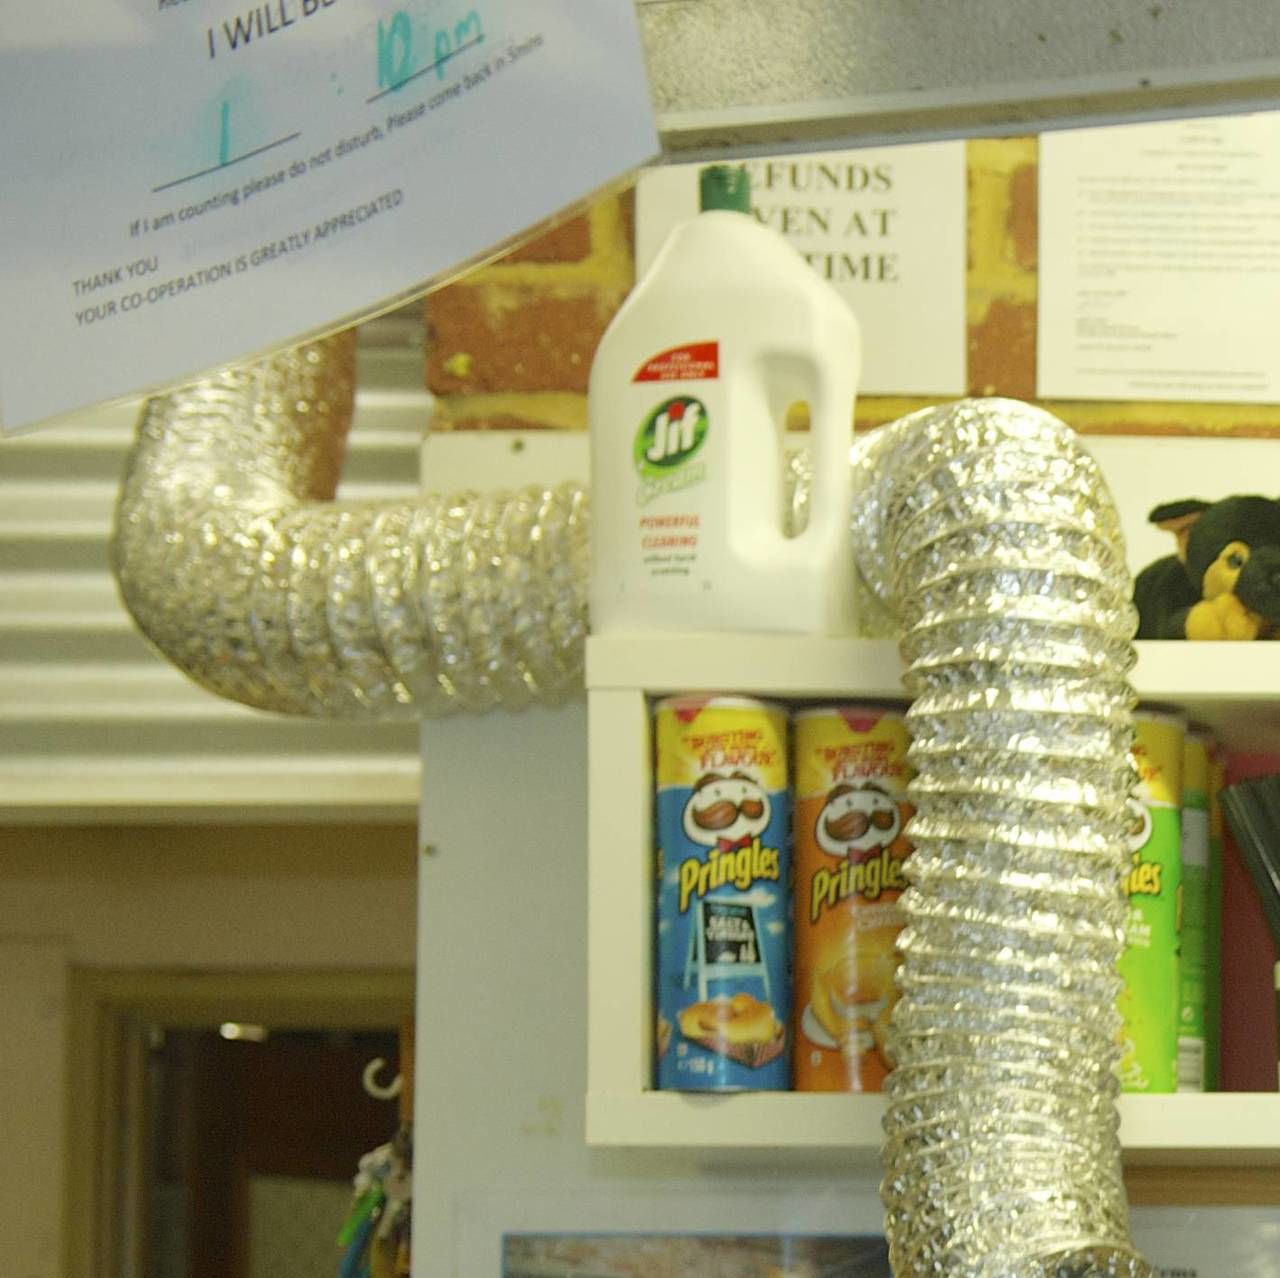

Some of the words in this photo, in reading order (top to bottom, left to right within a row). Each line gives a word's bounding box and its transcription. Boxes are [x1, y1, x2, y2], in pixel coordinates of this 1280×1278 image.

[206, 28, 216, 58] I
[224, 4, 296, 52] WILL
[152, 211, 175, 230] am
[178, 190, 239, 223] counting
[243, 168, 286, 202] please
[289, 159, 307, 184] do
[309, 147, 332, 169] not
[751, 206, 831, 235] VEN
[844, 209, 898, 236] AT
[72, 267, 122, 297] THANK
[126, 254, 160, 280] YOU
[74, 299, 118, 328] YOUR
[120, 263, 232, 314] CO-OPERATION
[234, 255, 248, 274] IS
[251, 228, 312, 267] GREATLY
[313, 188, 405, 243] APPRECIATED
[639, 514, 701, 530] POWERFUL
[641, 535, 698, 549] CLEANING
[677, 838, 780, 913] Pringles
